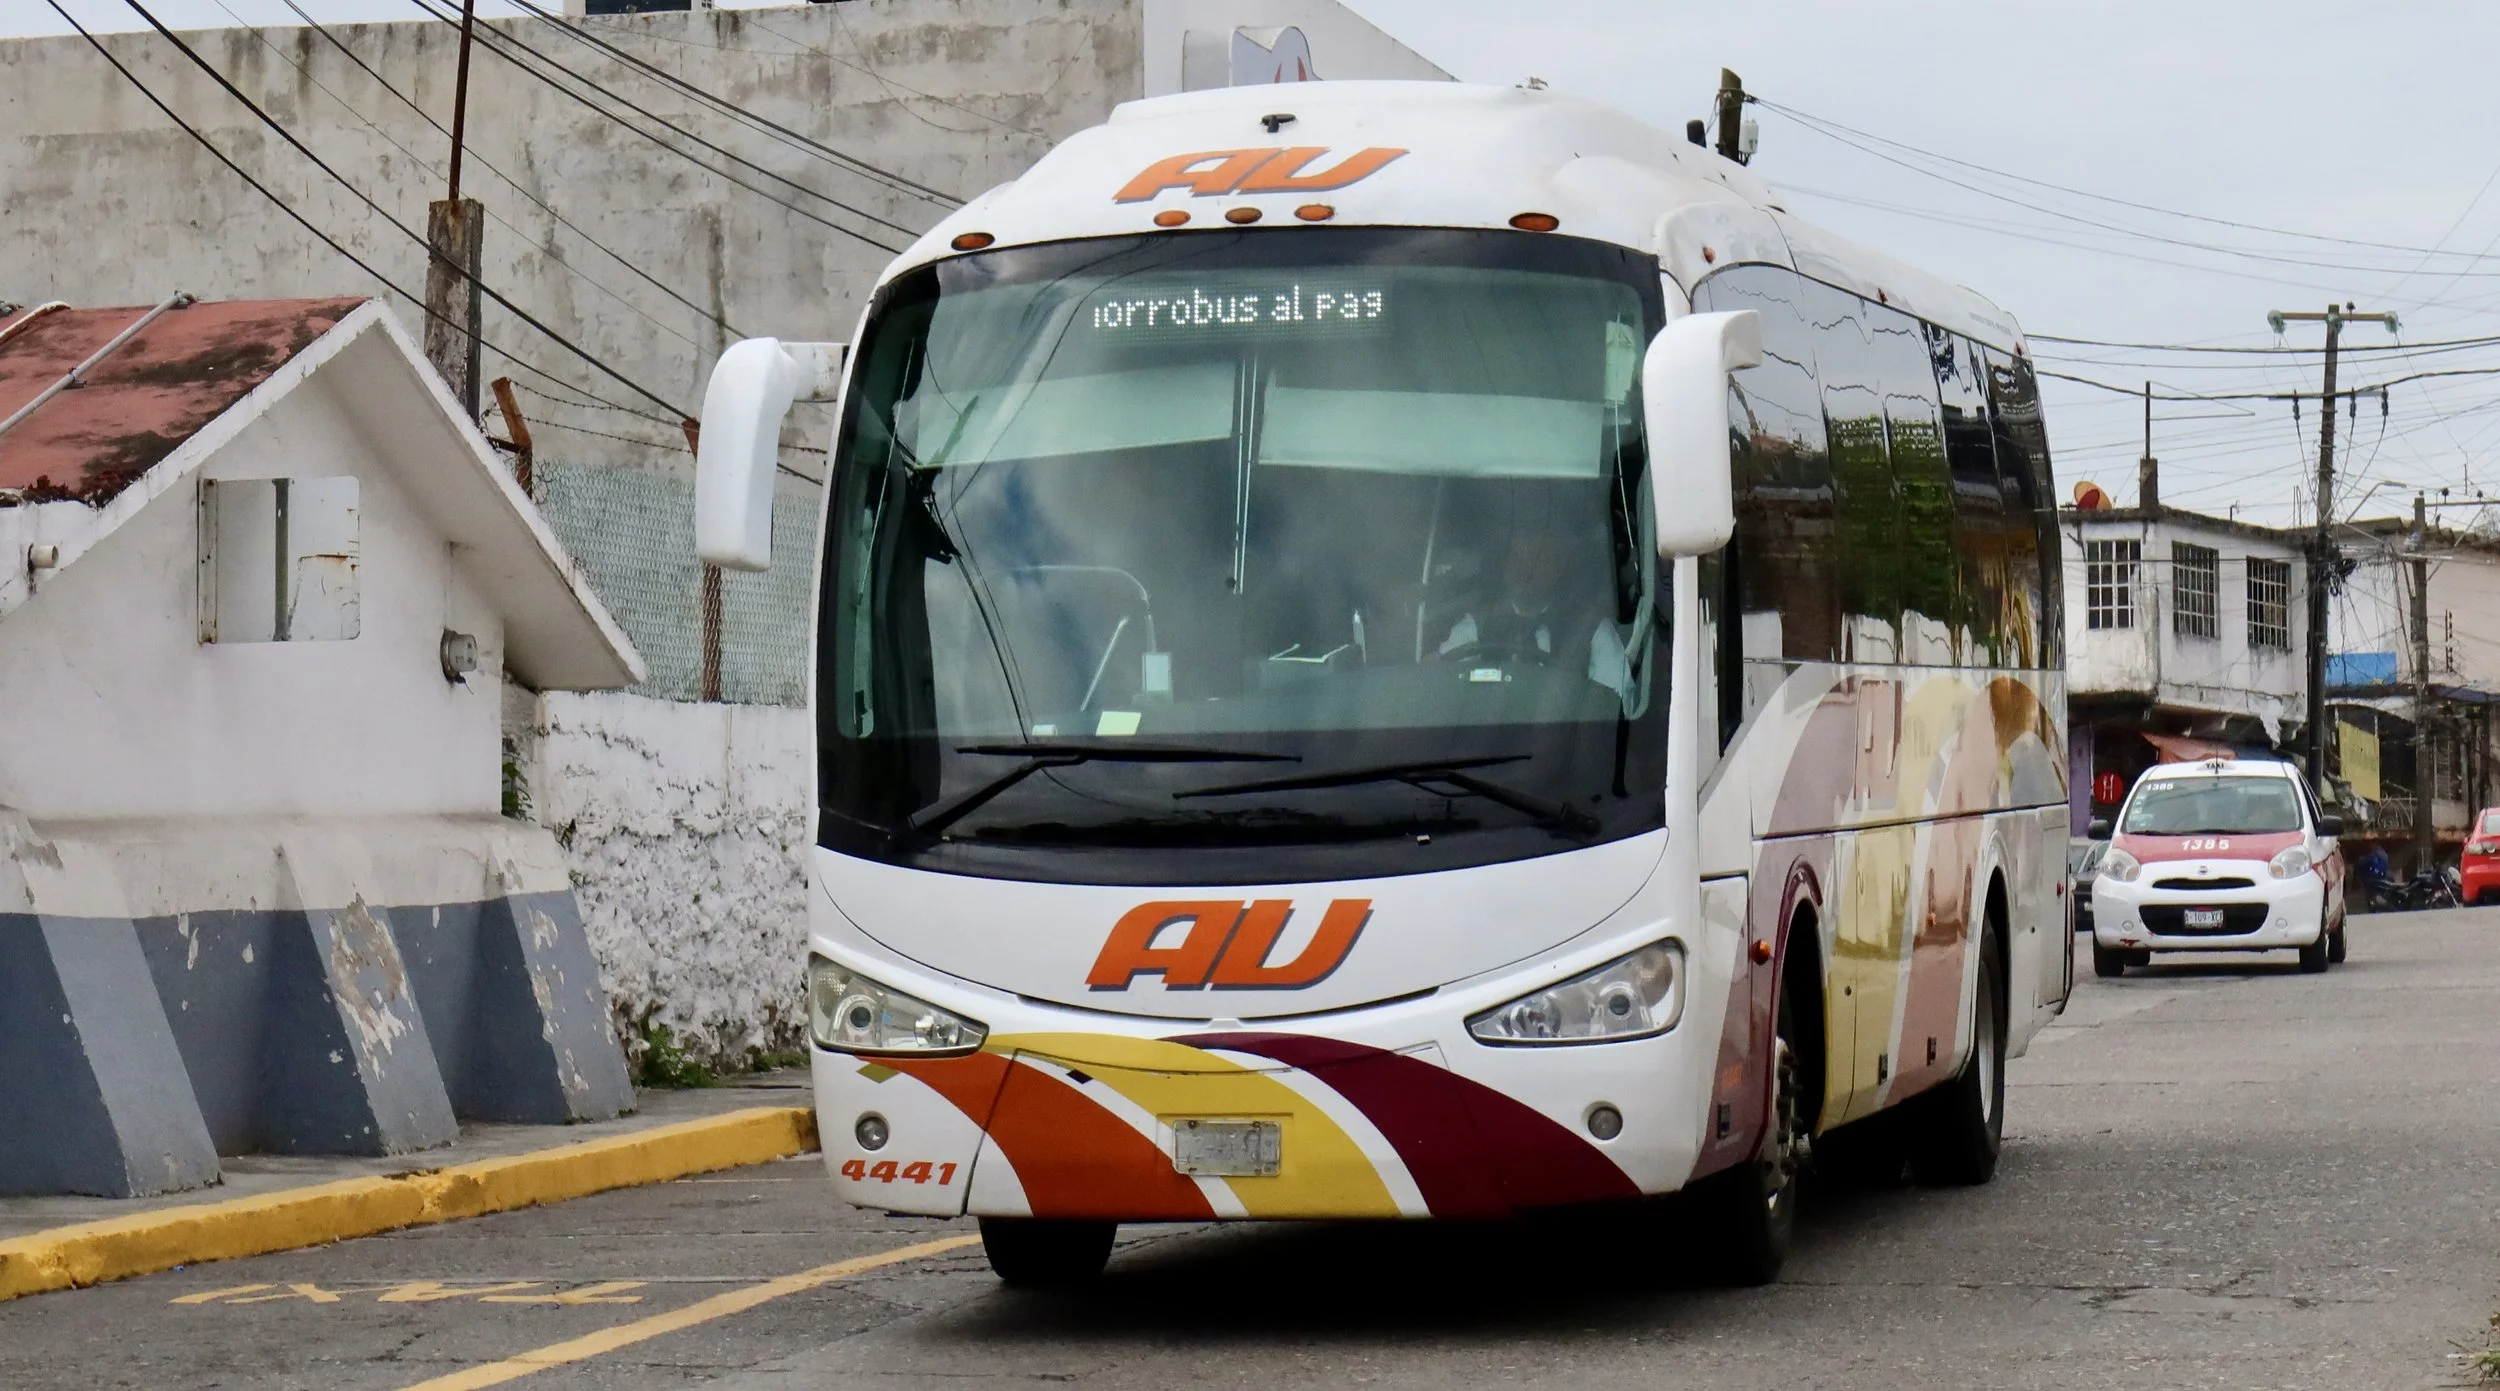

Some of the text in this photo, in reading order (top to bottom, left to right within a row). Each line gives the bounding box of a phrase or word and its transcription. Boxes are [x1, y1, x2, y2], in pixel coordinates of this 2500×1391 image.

[1111, 146, 1411, 205] AU
[1271, 284, 1304, 322] al
[2181, 839, 2231, 851] 1385
[1084, 898, 1375, 992] AU
[841, 1159, 958, 1186] 4441
